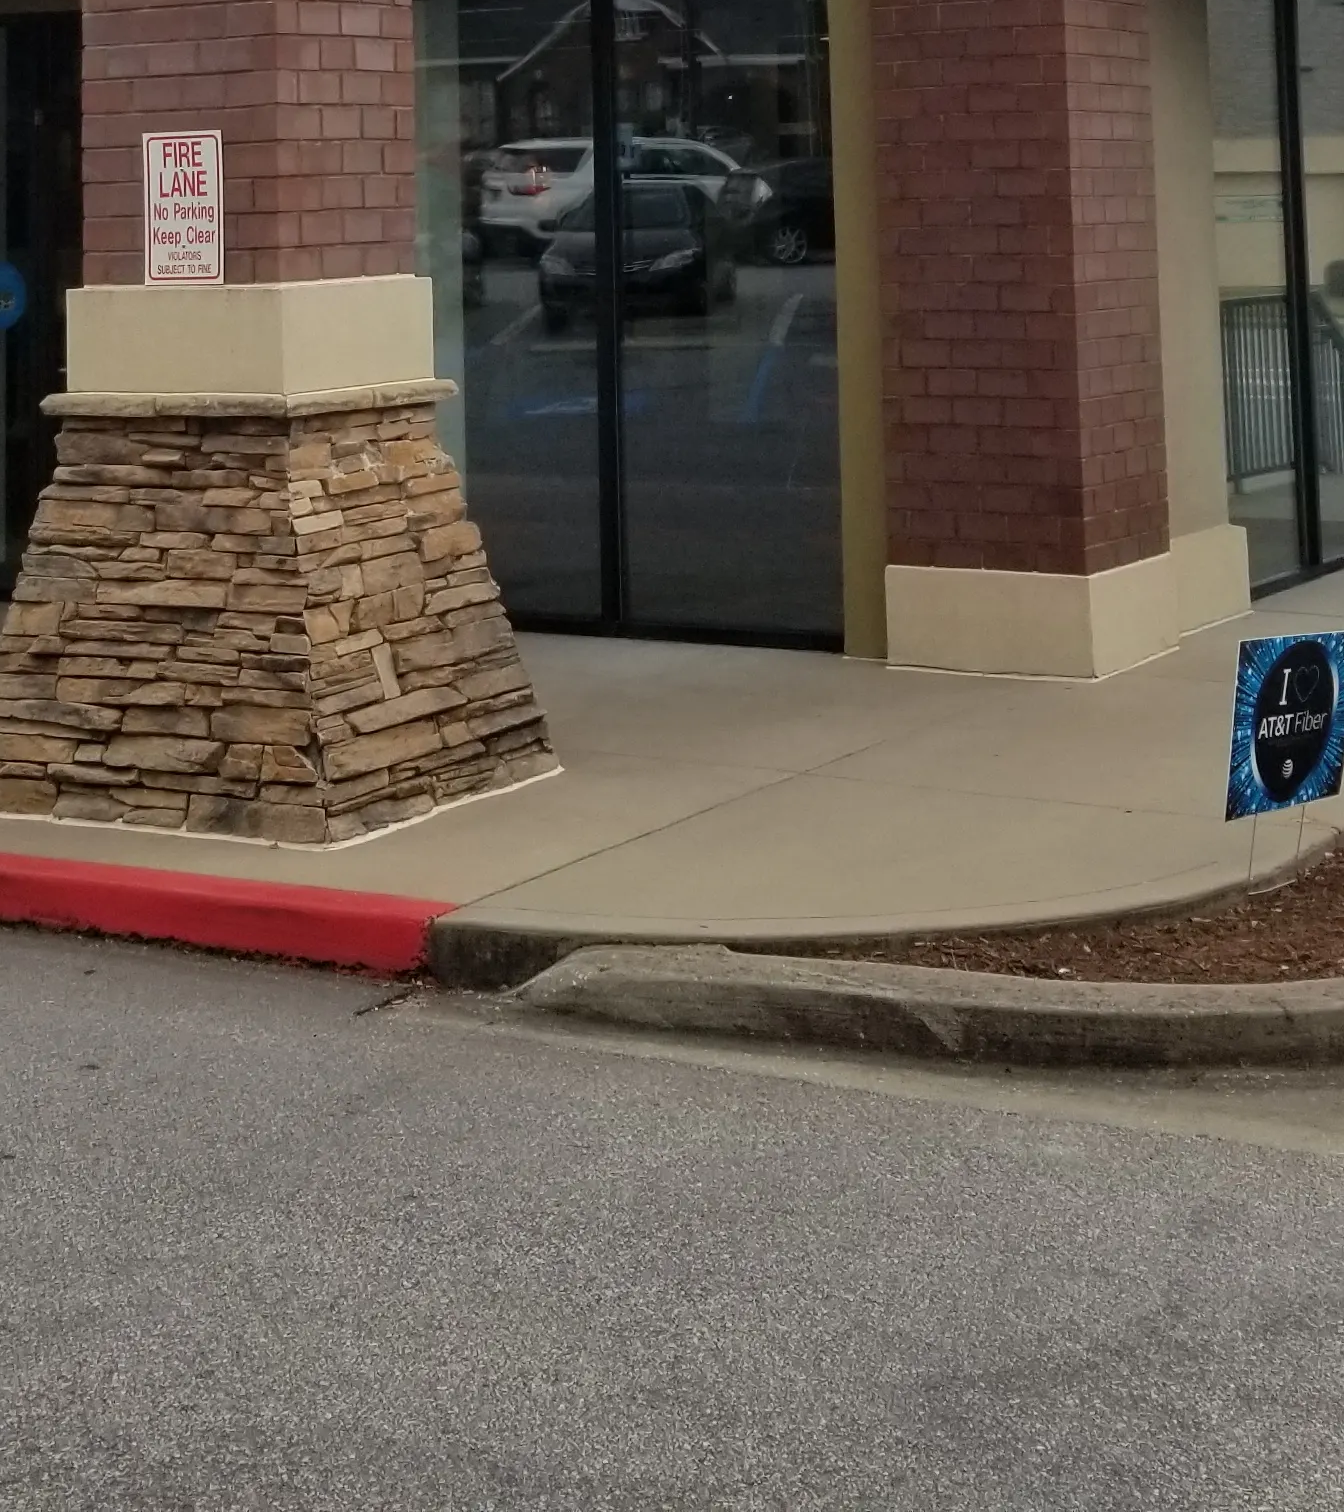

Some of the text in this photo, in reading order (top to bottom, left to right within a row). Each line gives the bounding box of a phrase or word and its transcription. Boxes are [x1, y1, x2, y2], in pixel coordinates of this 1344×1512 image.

[162, 141, 203, 169] FIRE
[159, 171, 208, 198] LANE
[154, 201, 215, 223] No Parking
[153, 225, 216, 248] Keep Clear
[168, 251, 202, 261] VIOLATORS
[157, 263, 212, 275] SUBJECT TO FINE
[1278, 668, 1292, 706] I
[1258, 711, 1329, 740] AT&T Fiber
